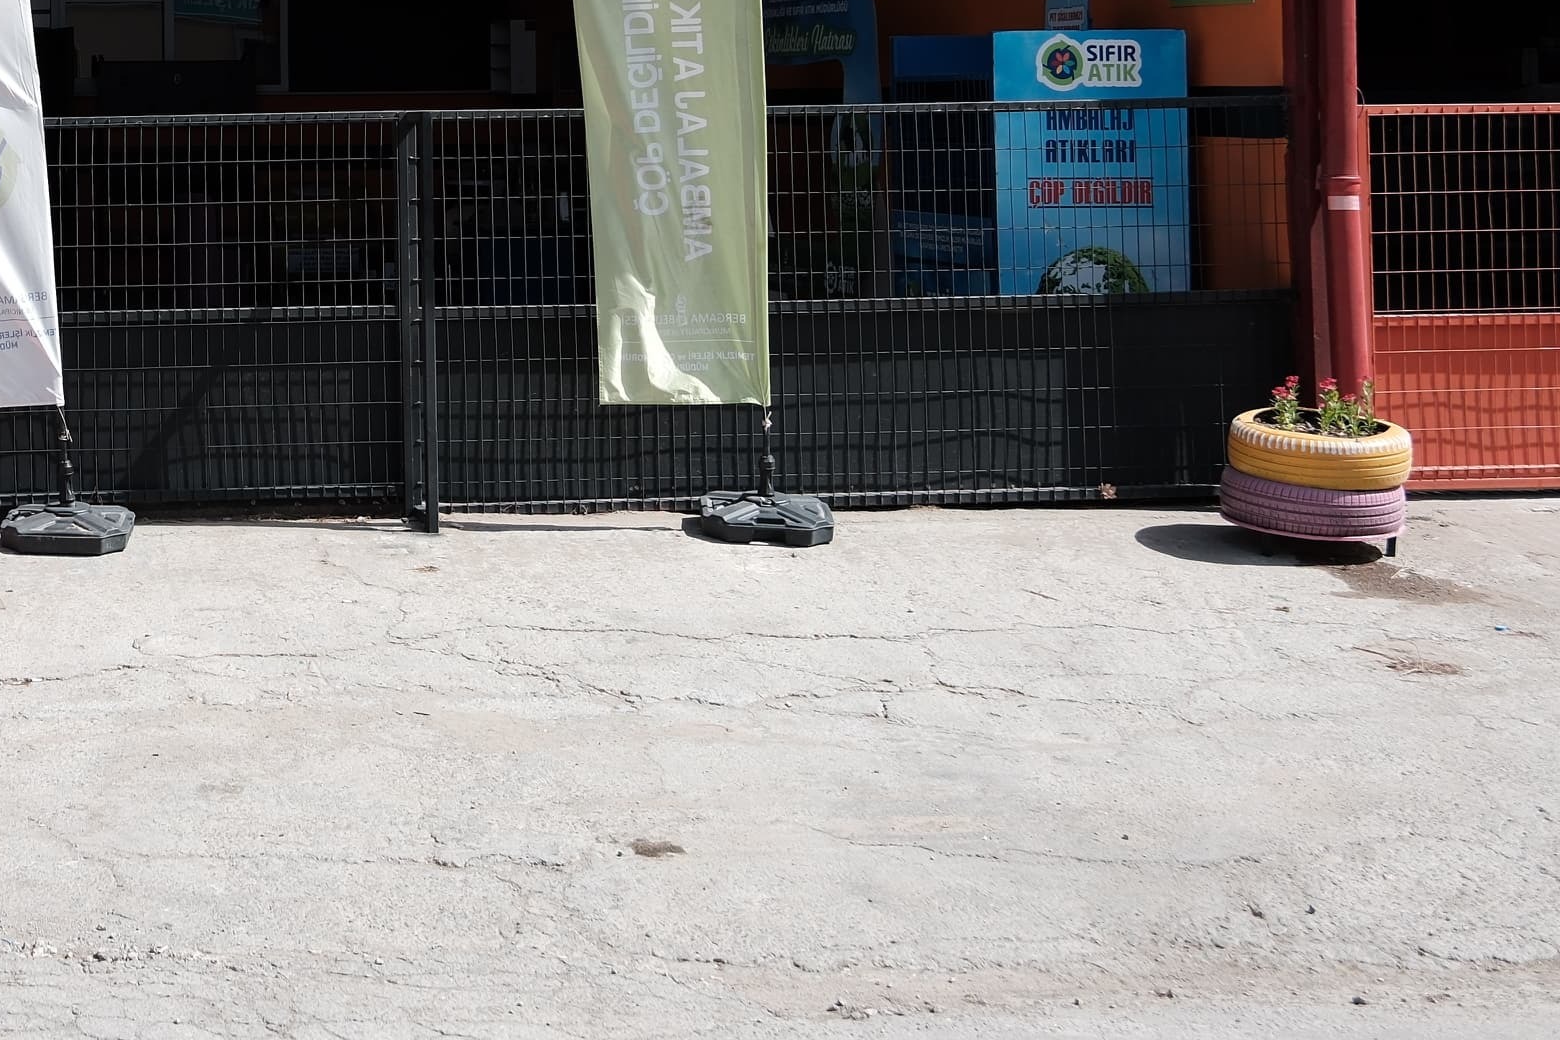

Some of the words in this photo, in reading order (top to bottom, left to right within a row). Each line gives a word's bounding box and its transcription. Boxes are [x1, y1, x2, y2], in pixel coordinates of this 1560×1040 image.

[811, 24, 855, 55] Hatırası
[1086, 45, 1136, 61] SIFIR
[1089, 63, 1137, 82] ATIK
[1046, 108, 1135, 131] AMBALAJ
[1045, 139, 1136, 163] ATIKLARI
[1028, 177, 1065, 208] ÇÖP
[1072, 177, 1153, 205] DEĞİLDİR
